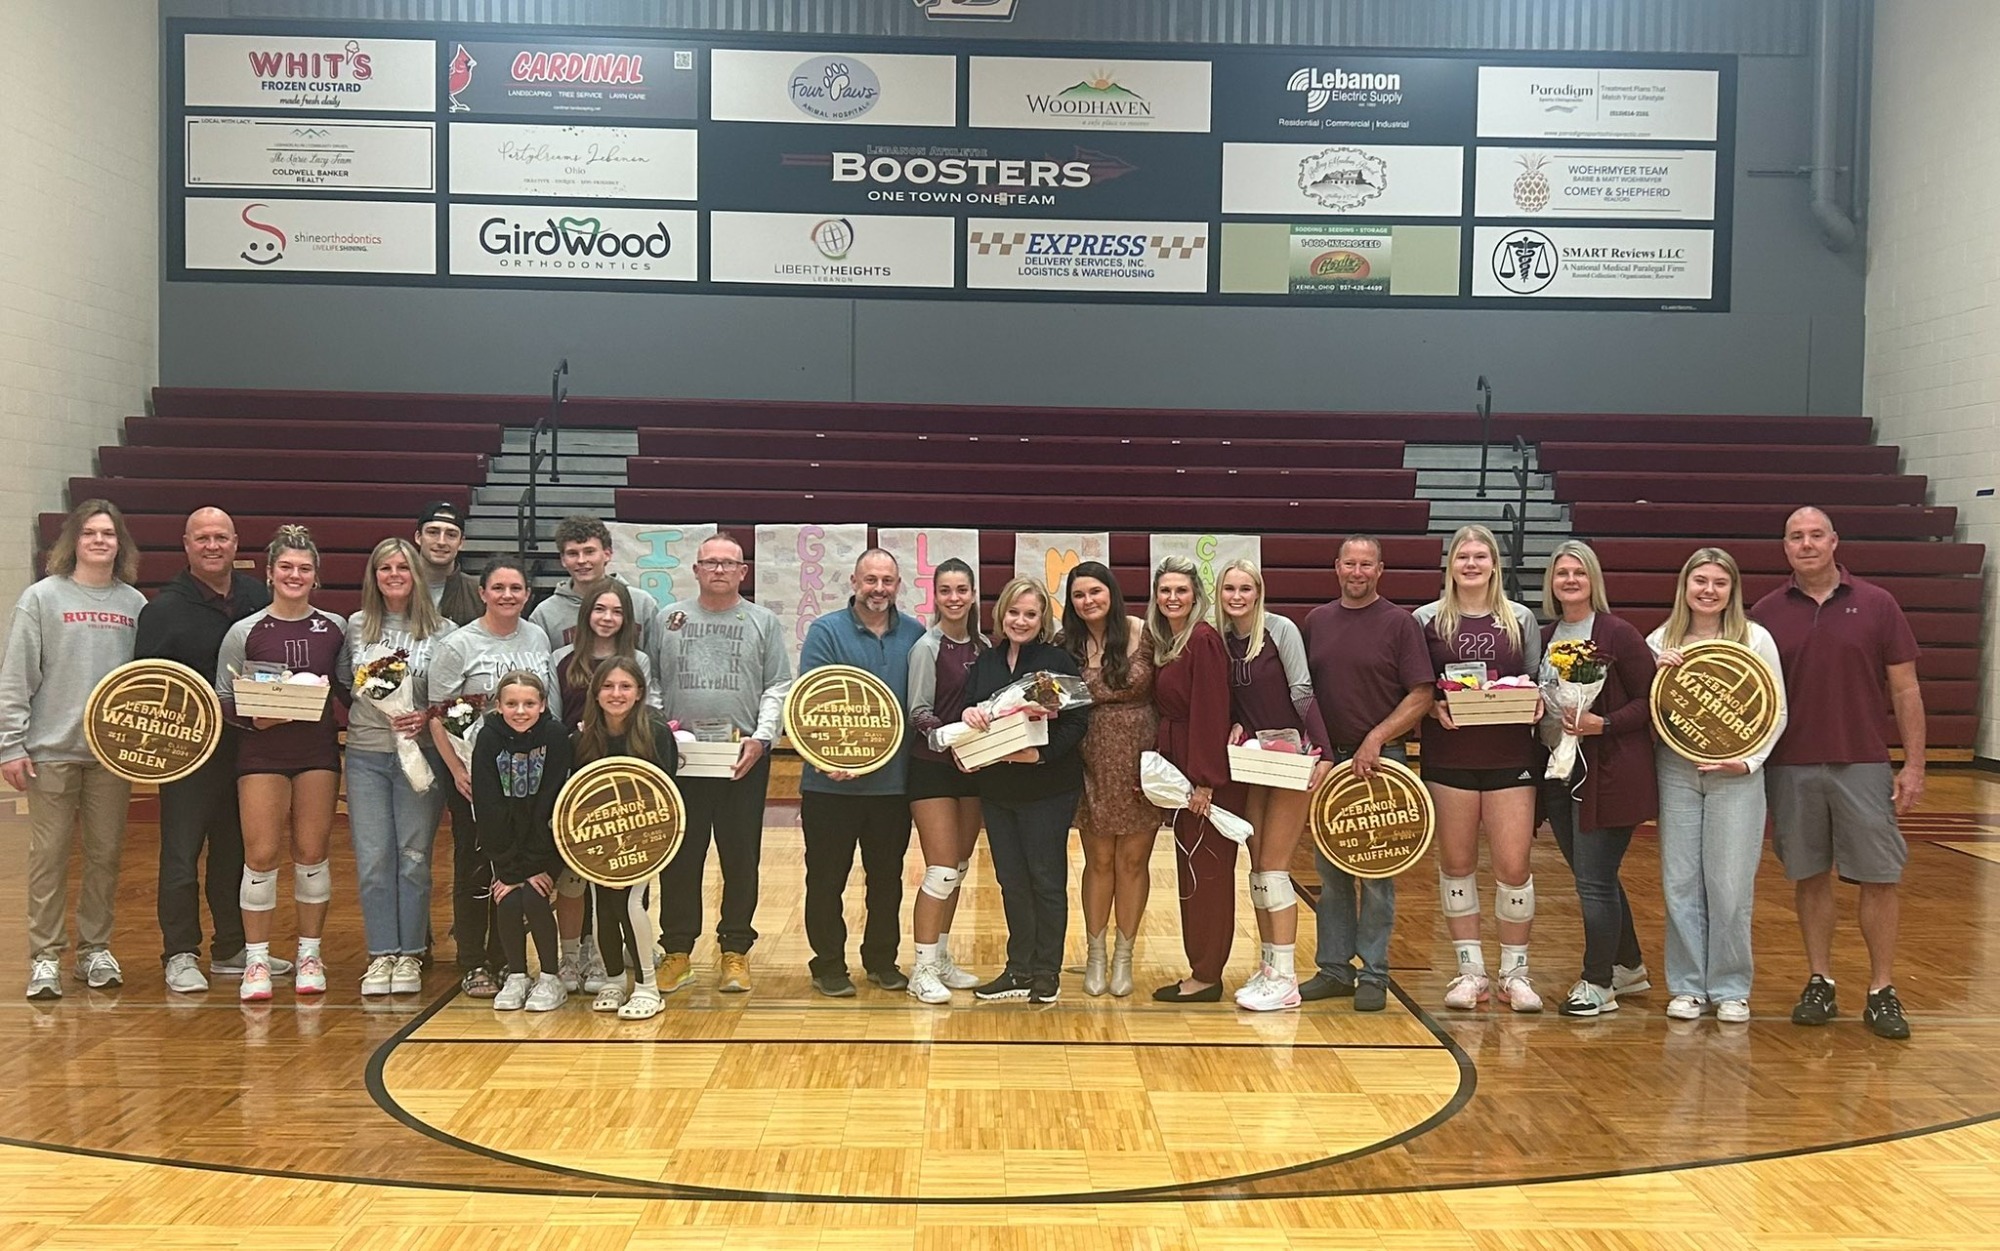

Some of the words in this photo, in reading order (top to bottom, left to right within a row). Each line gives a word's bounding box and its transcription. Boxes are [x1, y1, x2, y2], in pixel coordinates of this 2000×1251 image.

[249, 50, 373, 80] WHIT'S
[511, 51, 643, 84] CARDINAL
[1311, 68, 1401, 90] Lebanon
[261, 81, 307, 92] FROZEN
[309, 81, 361, 93] CUSTARD
[791, 77, 824, 99] Four
[830, 74, 877, 101] Paws
[1531, 84, 1593, 98] Paradigm
[280, 95, 300, 105] made
[301, 94, 320, 107] fresh
[320, 95, 341, 107] daily
[508, 90, 552, 98] LANDSCAPING
[576, 91, 603, 99] SERVICE
[609, 92, 628, 100] LAWN
[1332, 90, 1367, 102] Electric
[1369, 91, 1403, 105] Supply
[802, 103, 829, 118] ANIMAL
[833, 105, 868, 118] HOSPITAL
[1279, 118, 1320, 127] Residential
[1325, 119, 1370, 128] Commercial
[1376, 120, 1410, 128] Industrial
[586, 143, 650, 165] Lebanon
[272, 168, 315, 176] COLDWELL
[317, 169, 349, 177] BANKER
[564, 167, 586, 175] Ohio
[831, 151, 1091, 188] BOOSTERS
[1568, 165, 1636, 175] WOEHRMYER
[1638, 166, 1669, 176] TEAM
[868, 190, 904, 202] ONE
[909, 191, 961, 203] TOWN
[967, 193, 1001, 204] ONE
[1007, 194, 1055, 205] TEAM
[1564, 186, 1603, 196] COMEY
[1605, 187, 1613, 196] &
[1615, 187, 1671, 197] SHEPHERD
[1026, 232, 1148, 257] EXPRESS
[1301, 239, 1381, 248] 1-800-HYDROSEED
[1562, 247, 1608, 258] SMART
[1611, 248, 1655, 259] Reviews
[1658, 248, 1685, 259] LLC
[500, 259, 651, 271] ORTHODONTICS
[1025, 256, 1072, 266] DELIVERY
[1075, 257, 1126, 268] SERVICES,
[1127, 258, 1147, 268] INC.
[1571, 263, 1600, 271] National
[1603, 264, 1631, 272] Medical
[1633, 264, 1665, 273] Paralegal
[1018, 266, 1070, 277] LOGISTICS
[1072, 267, 1079, 277] &
[1081, 268, 1155, 278] WAREHOUSING
[63, 611, 136, 629] RUTGERS
[285, 639, 310, 668] 11
[1458, 632, 1496, 660] 22
[678, 672, 740, 691] VOLLEYBALL
[1670, 689, 1689, 709] #22
[1698, 672, 1748, 716] LEBANON
[125, 701, 187, 723] LEBANON
[816, 704, 871, 714] LEBANON
[1674, 670, 1754, 741] WARRIORS
[102, 708, 204, 743] WARRIORS
[800, 714, 892, 728] WARRIORS
[108, 731, 127, 742] #11
[810, 732, 830, 741] #15
[1668, 710, 1711, 750] WHITE
[118, 749, 167, 769] BOLEN
[821, 746, 876, 757] GILARDI
[586, 800, 646, 823] LEBANON
[1341, 799, 1398, 817] LEBANON
[569, 807, 671, 844] WARRIORS
[1325, 807, 1420, 835] WARRIORS
[586, 845, 604, 855] #2
[1339, 838, 1359, 848] #10
[608, 850, 648, 870] BUSH
[1348, 846, 1410, 863] KAUFFMAN
